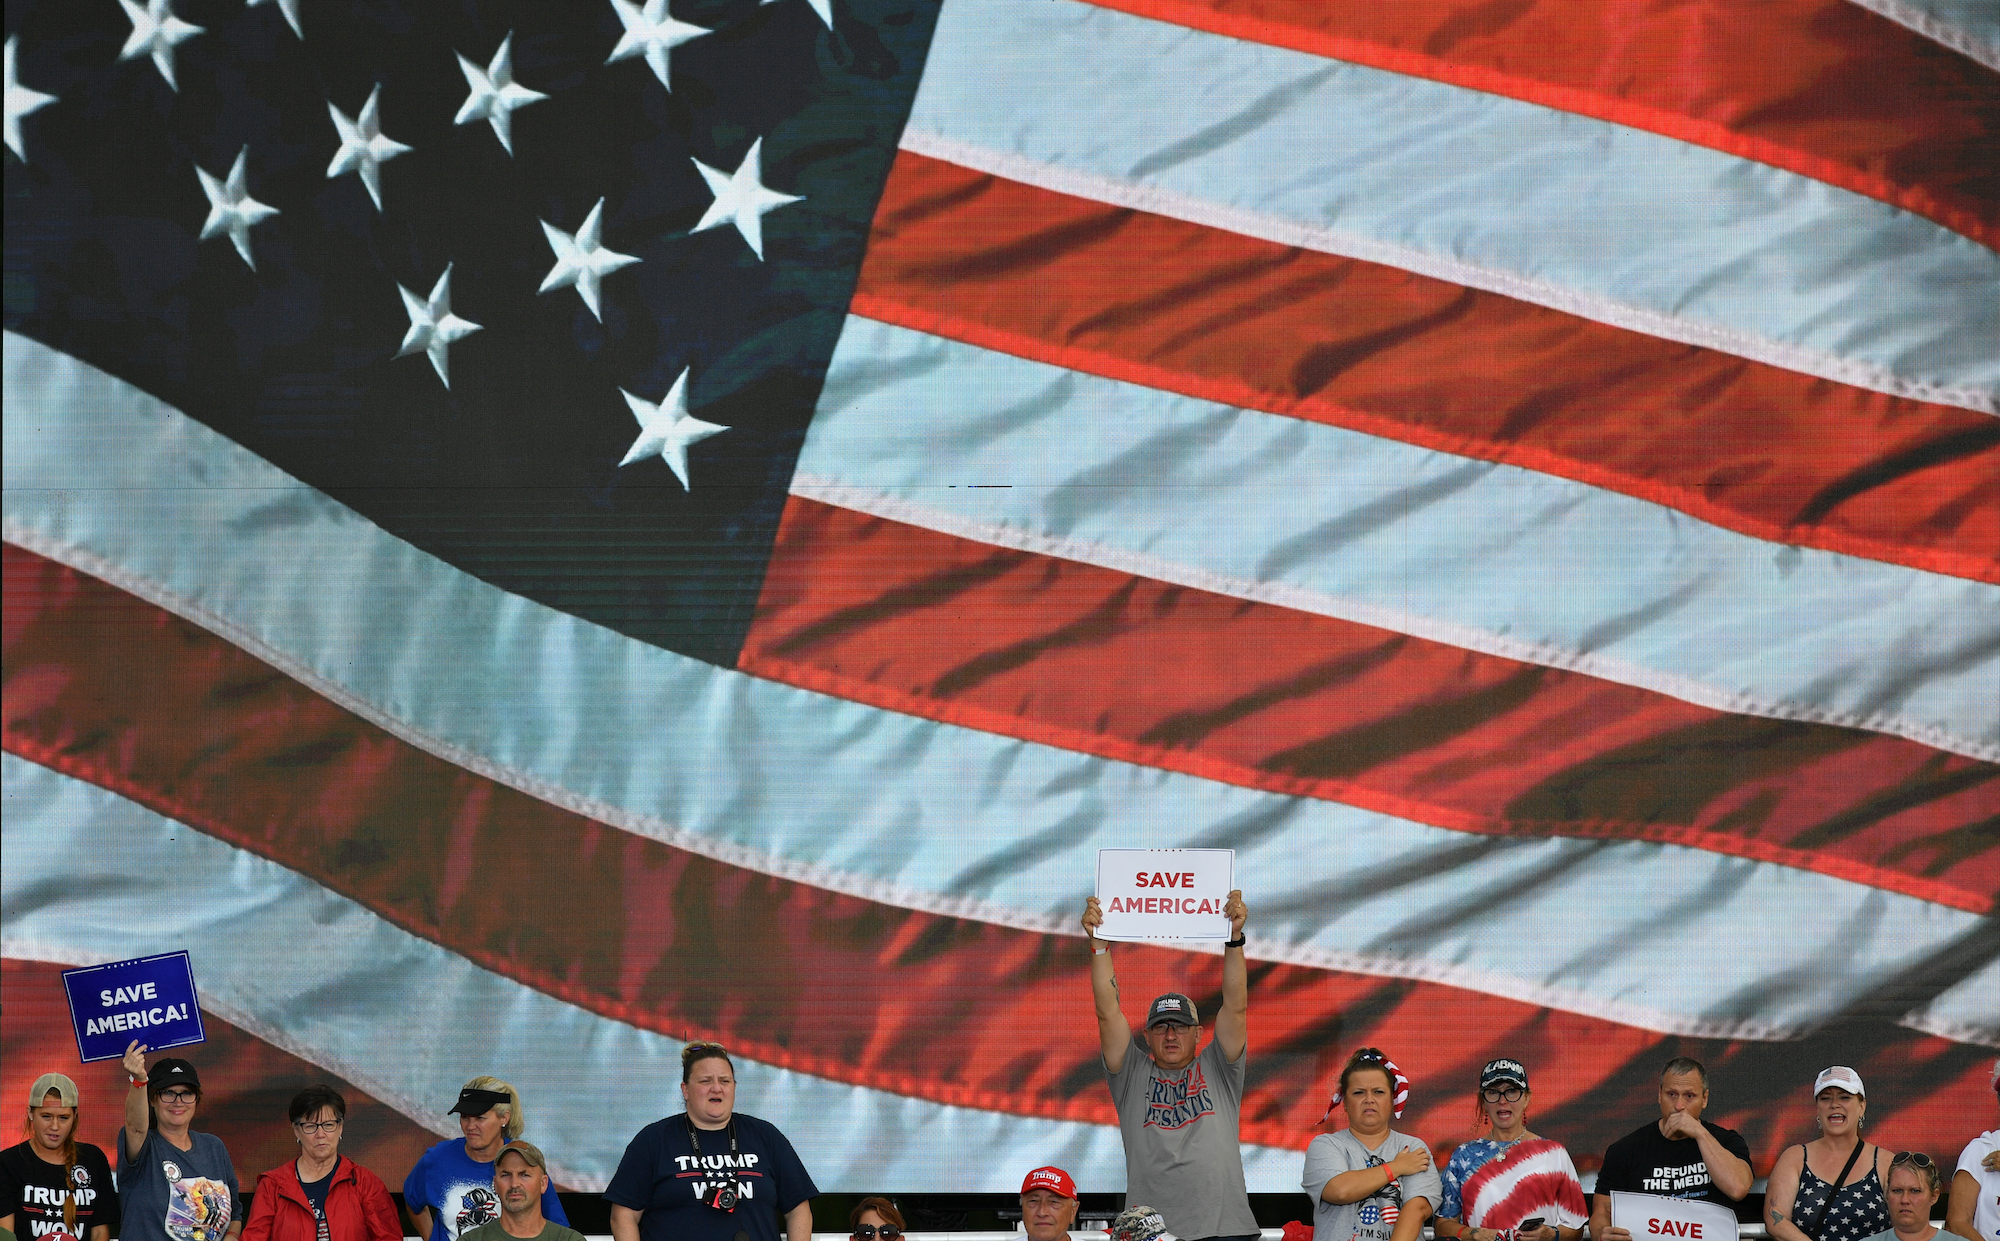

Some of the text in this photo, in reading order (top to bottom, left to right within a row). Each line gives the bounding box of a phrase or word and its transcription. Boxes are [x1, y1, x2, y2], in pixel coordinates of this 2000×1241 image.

[1135, 872, 1195, 888] SAVE
[1108, 897, 1220, 914] AMERICA!
[100, 982, 157, 1007] SAVE
[86, 1003, 188, 1036] AMERICA!
[1482, 1060, 1525, 1077] ALABAMA
[674, 1153, 759, 1171] TRUMP
[1653, 1162, 1707, 1179] DEFUND
[1032, 1170, 1062, 1184] Trump
[1643, 1174, 1712, 1190] THE MEDI
[24, 1185, 96, 1206] TRUMP
[691, 1181, 754, 1199] WN
[1360, 1228, 1374, 1238] I'M
[1648, 1218, 1703, 1239] SAVE
